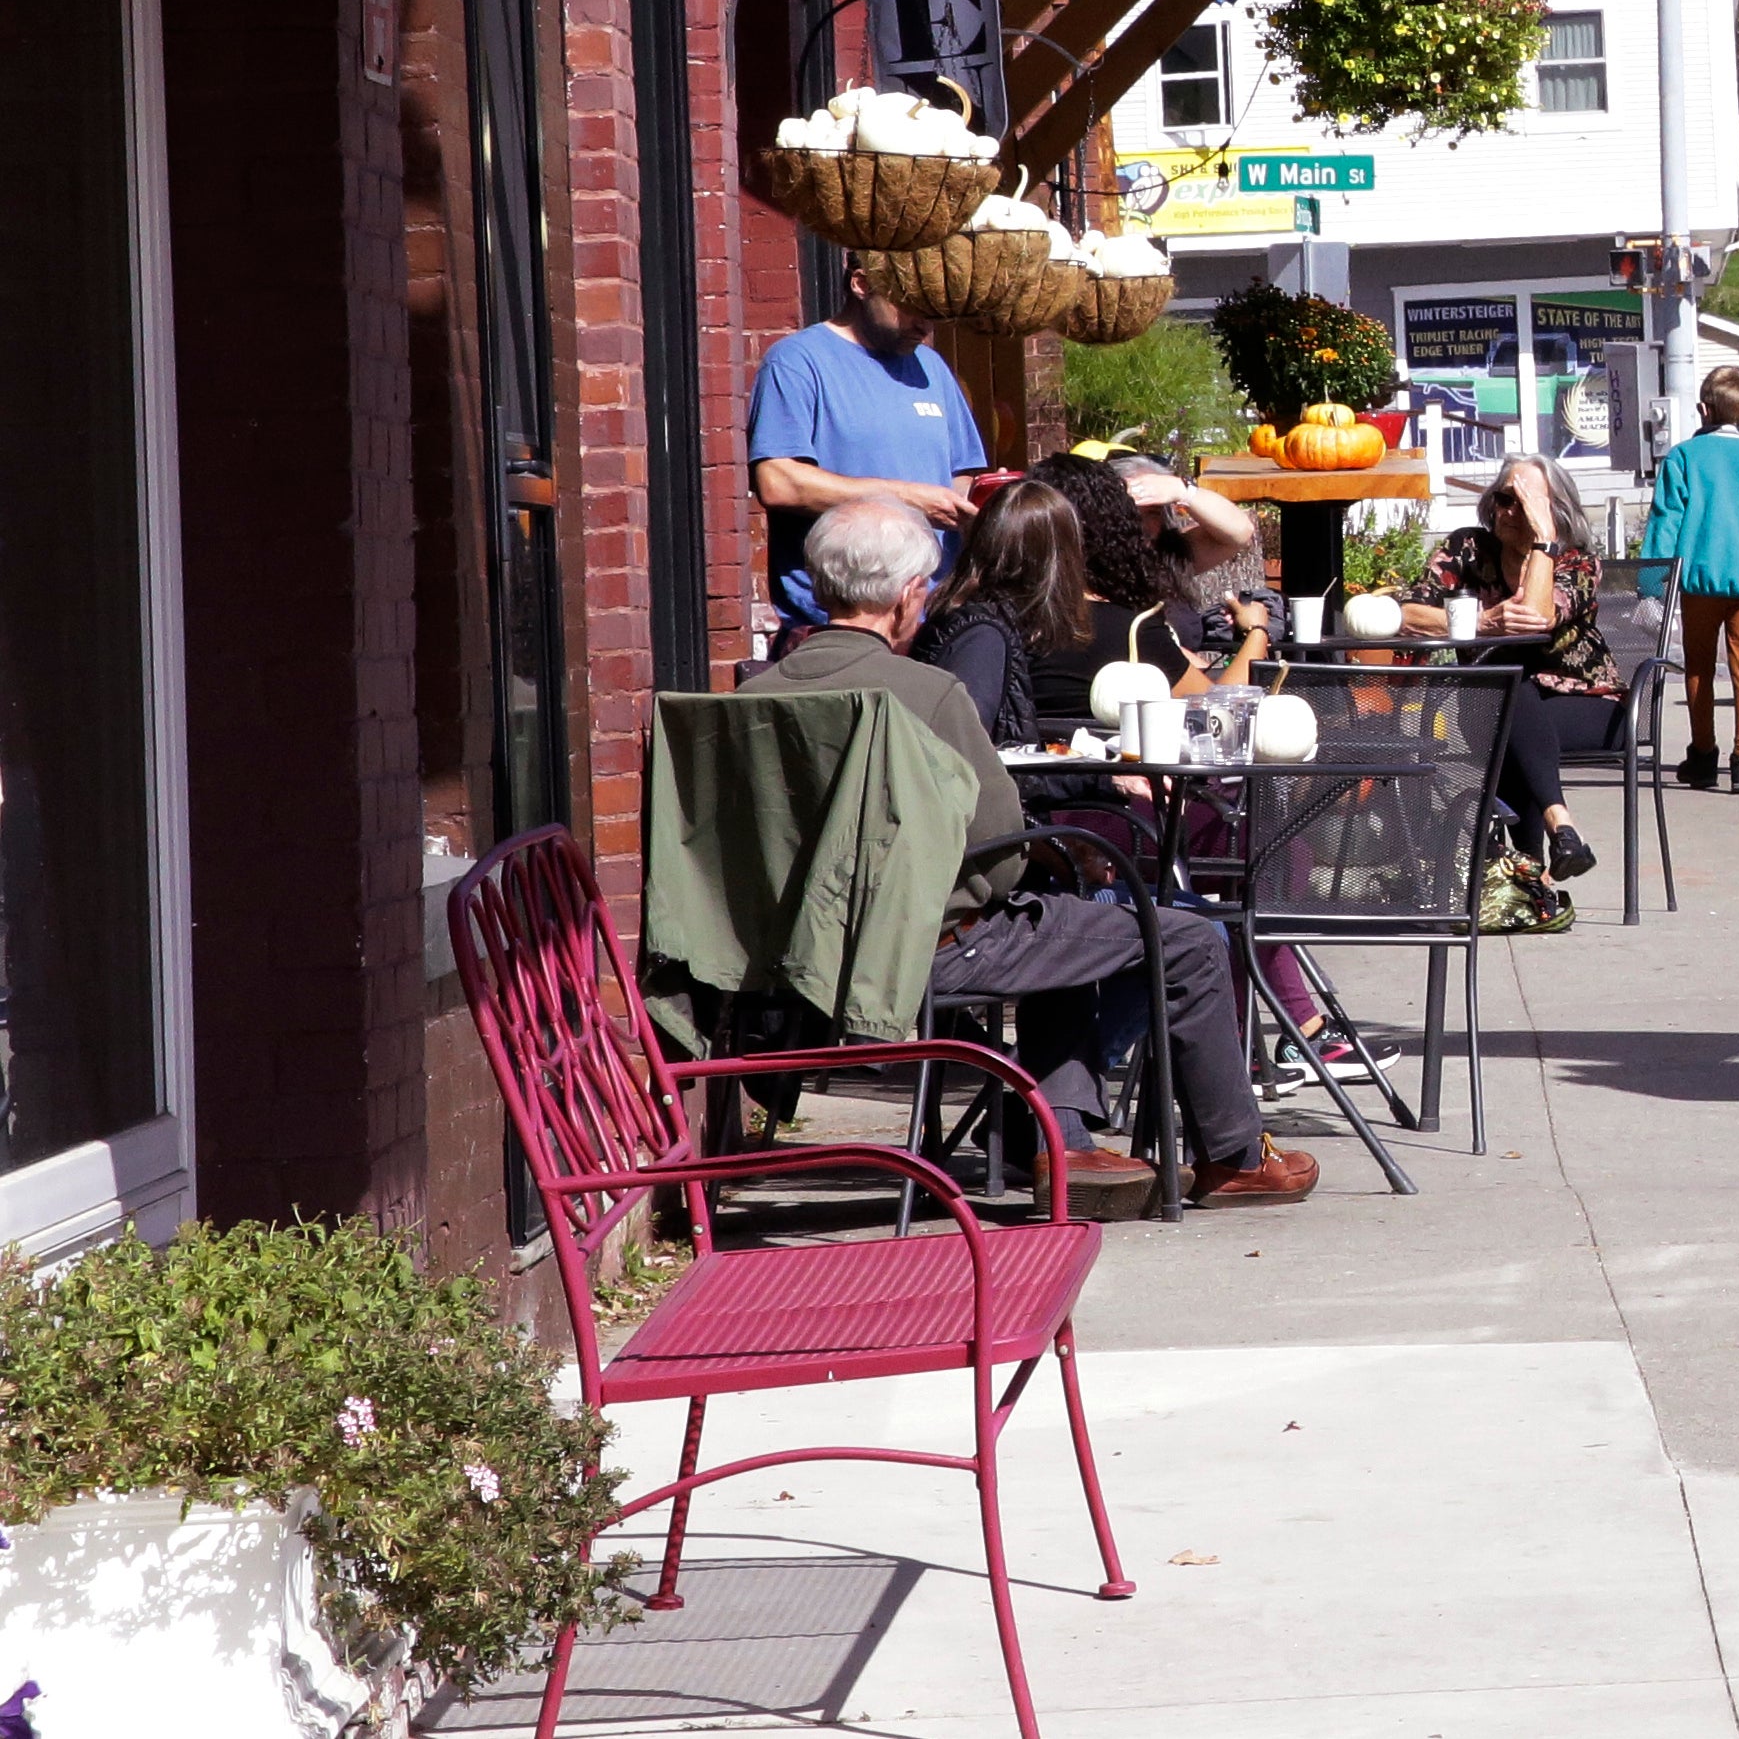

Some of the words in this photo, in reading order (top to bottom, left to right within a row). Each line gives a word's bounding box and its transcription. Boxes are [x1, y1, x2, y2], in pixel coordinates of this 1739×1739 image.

[1248, 163, 1268, 185] W
[1280, 163, 1336, 185] Main
[1349, 167, 1366, 184] St
[1407, 304, 1514, 322] WINTERSTEIGER
[1537, 307, 1580, 326] STATE
[1584, 311, 1601, 327] OF
[1603, 313, 1623, 328] THE
[1409, 330, 1456, 343] TRIMJET
[1459, 328, 1500, 341] RACING
[1413, 345, 1443, 358] EDGE
[1447, 343, 1484, 356] TUNER
